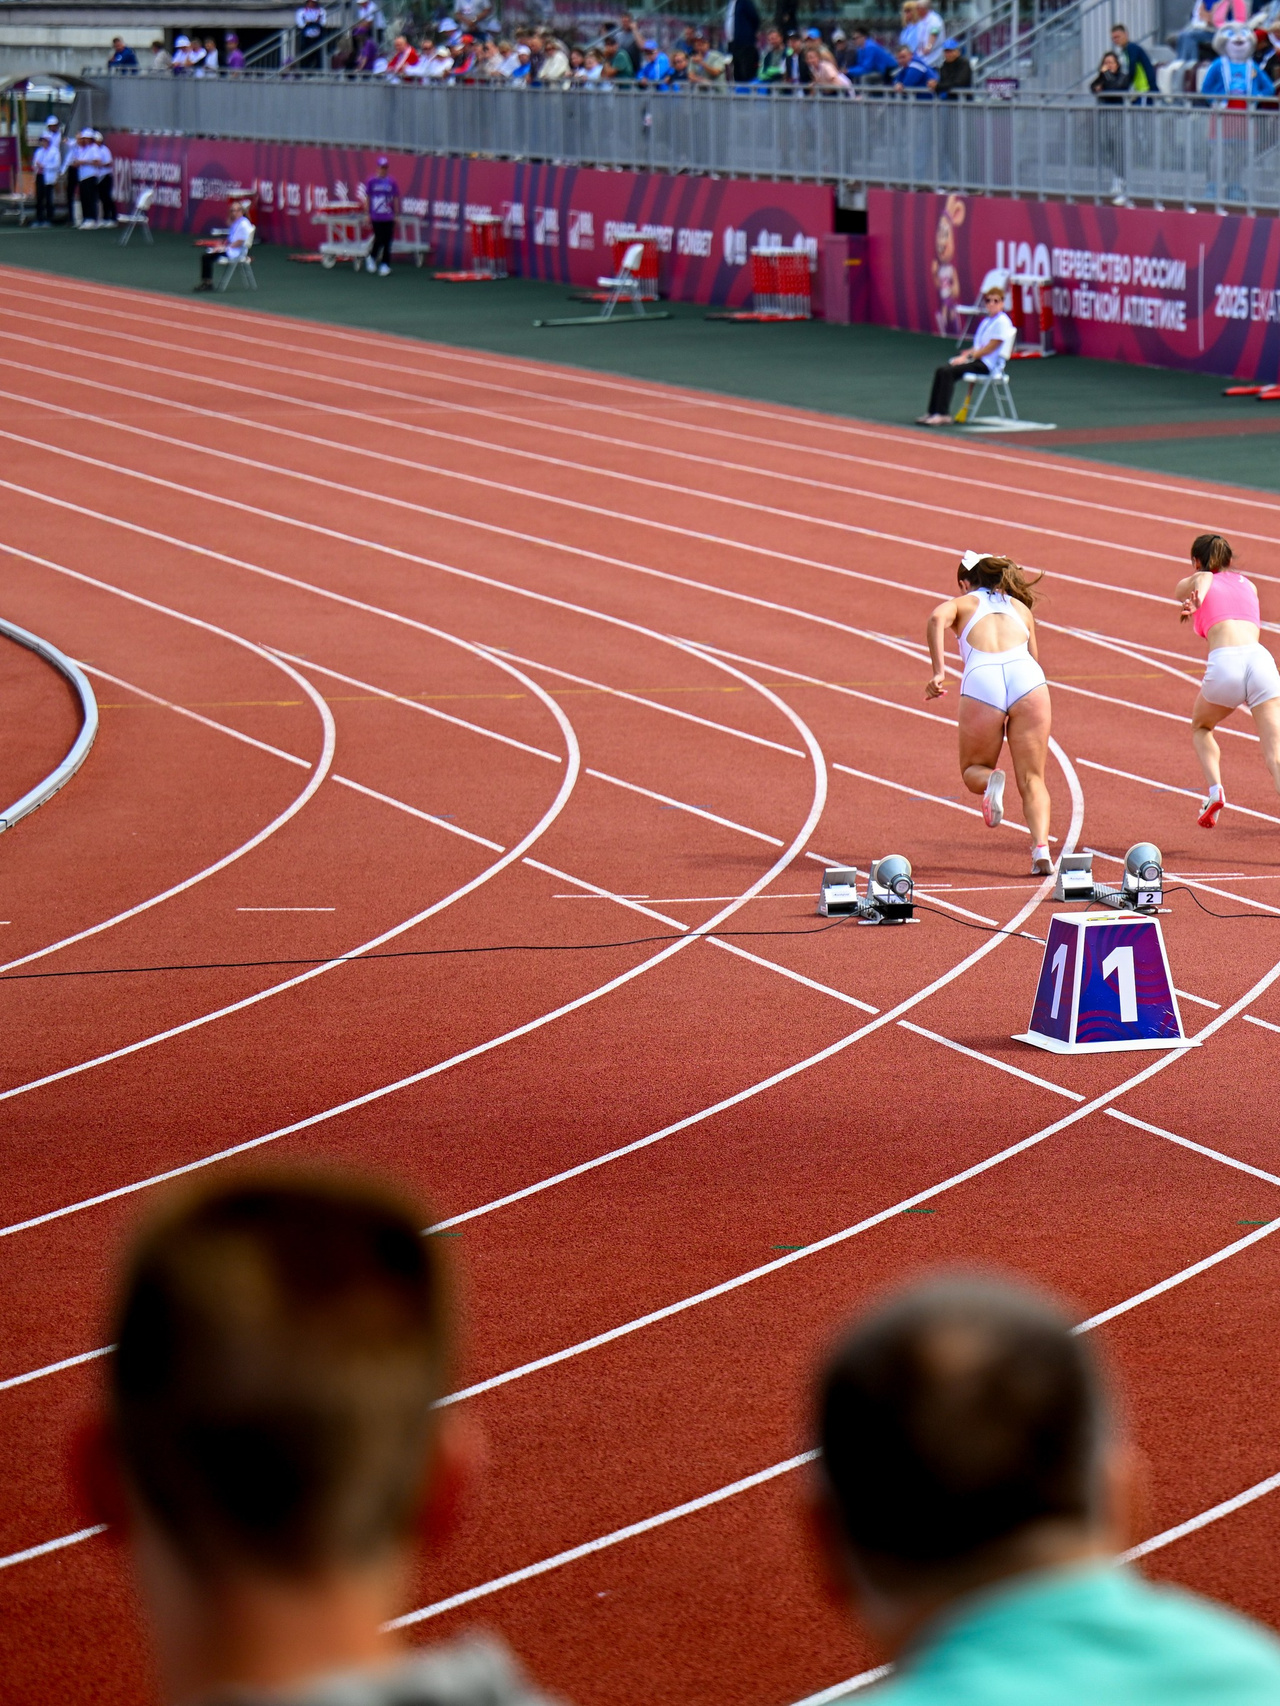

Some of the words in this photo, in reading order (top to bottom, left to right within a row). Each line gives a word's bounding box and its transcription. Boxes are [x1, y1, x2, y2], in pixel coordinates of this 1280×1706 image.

[1052, 247, 1131, 285] ПЕРВЕНСТВО
[1133, 256, 1187, 291] РОССИИ
[1052, 286, 1071, 317] ПО
[1071, 282, 1121, 325] ЛЁГКОЙ
[1122, 294, 1187, 332] АТЛЕТИКЕ
[1215, 283, 1249, 320] 2025
[1145, 893, 1154, 903] 2
[1050, 943, 1070, 1020] 1
[1101, 945, 1139, 1023] 1
